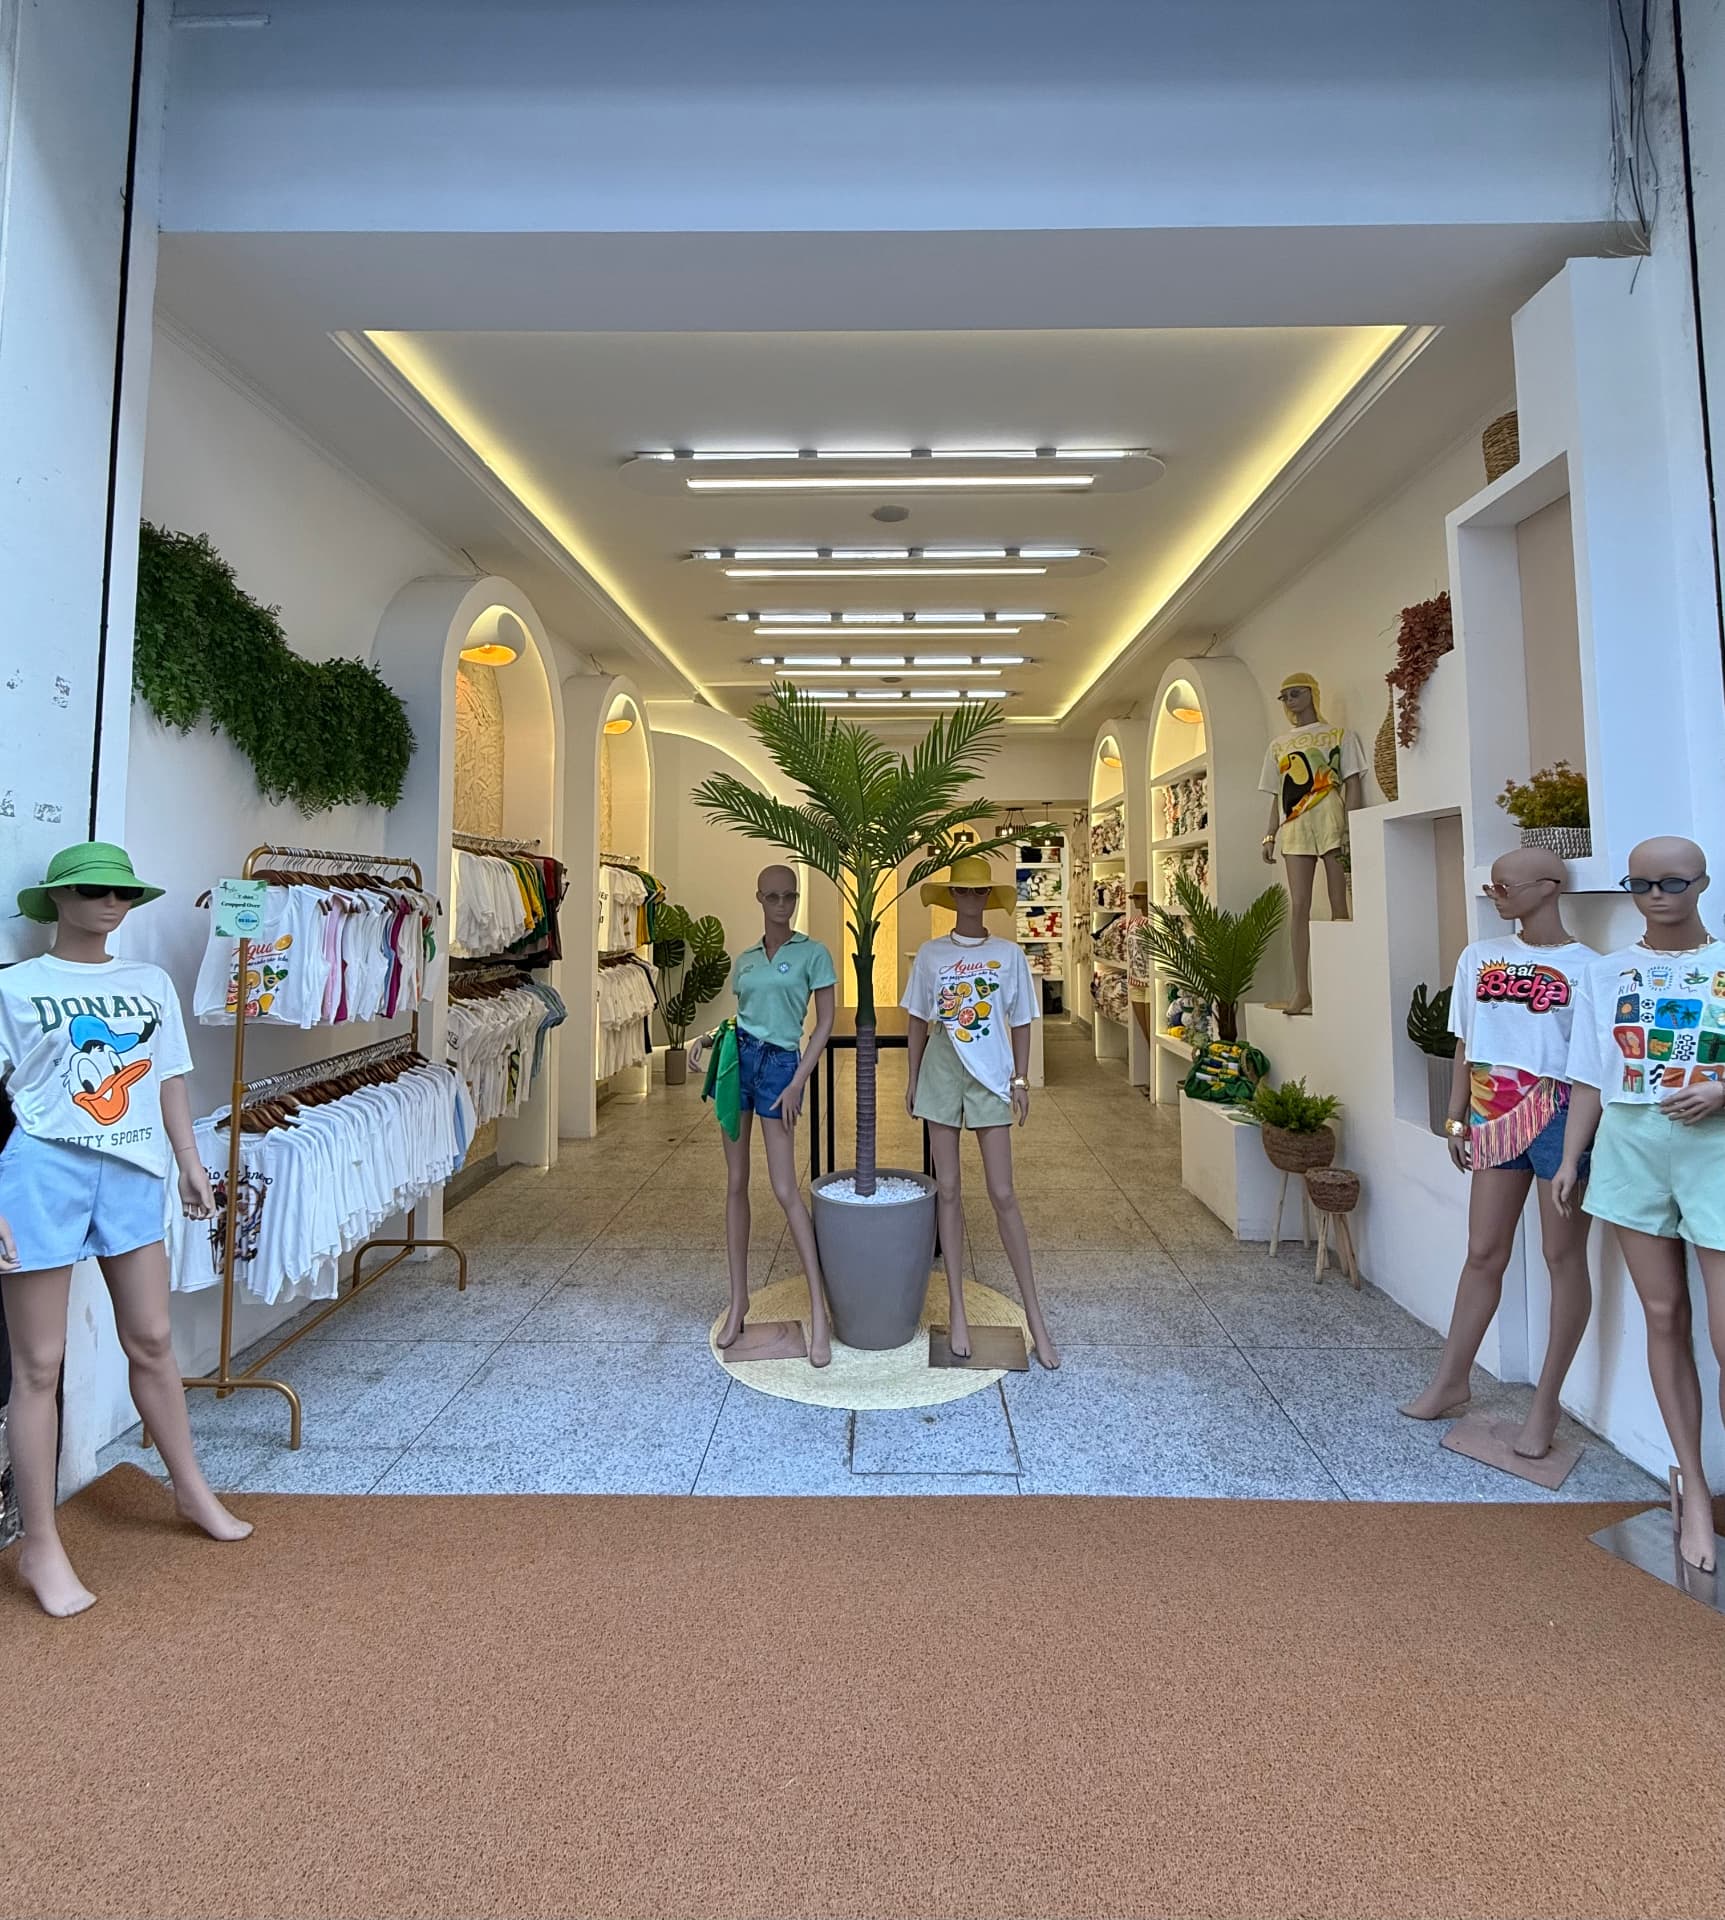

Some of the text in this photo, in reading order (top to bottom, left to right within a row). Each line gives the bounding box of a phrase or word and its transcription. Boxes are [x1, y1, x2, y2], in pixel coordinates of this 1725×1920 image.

[1477, 970, 1568, 1011] Bicha
[1618, 982, 1637, 995] RIO
[111, 1127, 152, 1146] SPORTS
